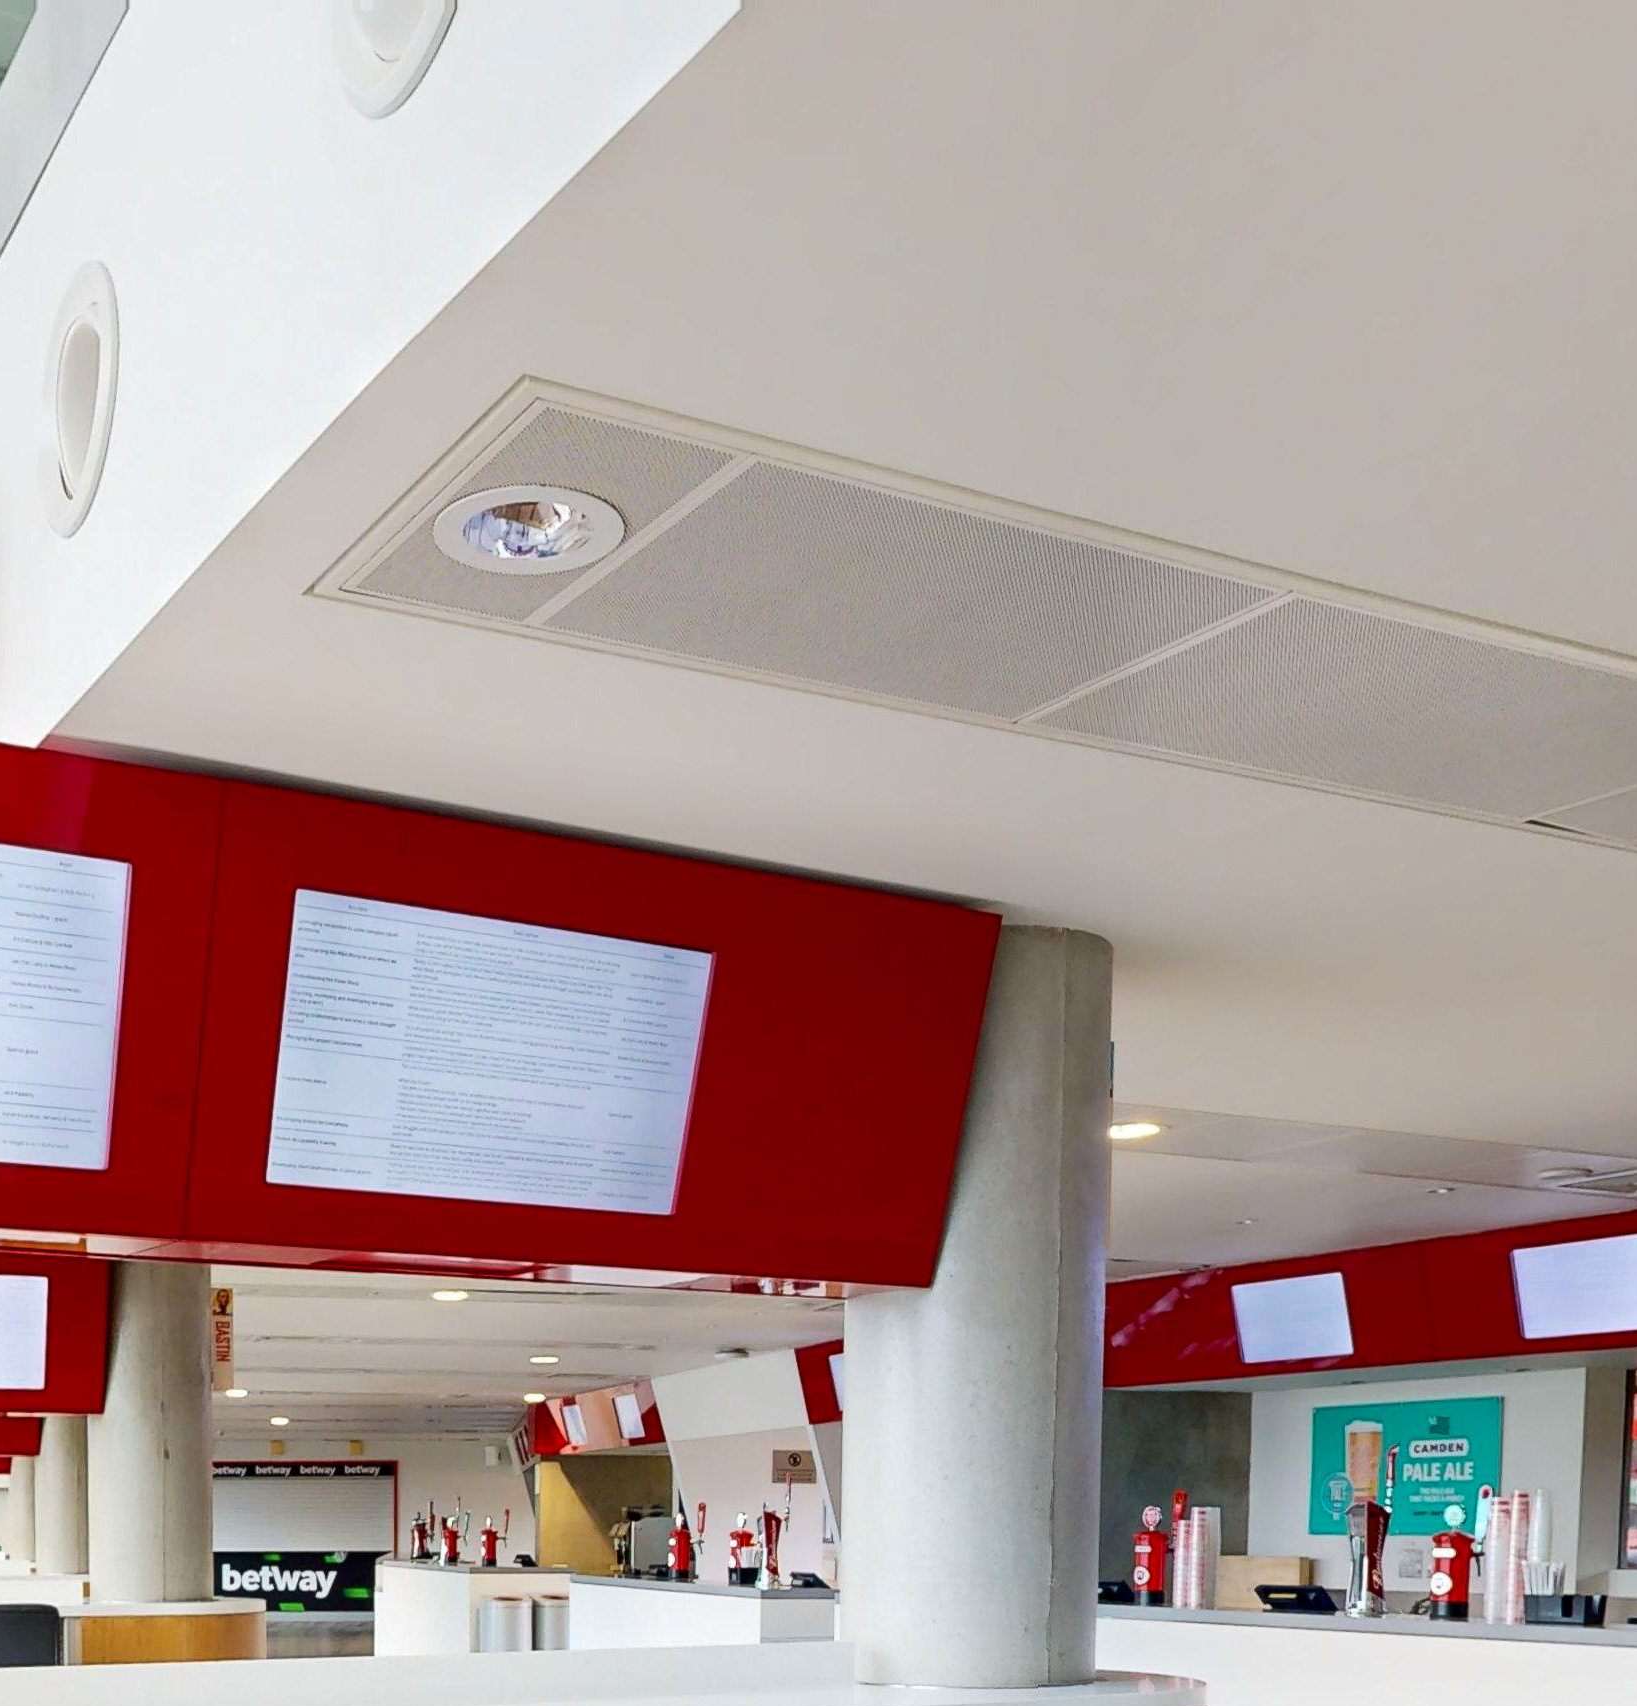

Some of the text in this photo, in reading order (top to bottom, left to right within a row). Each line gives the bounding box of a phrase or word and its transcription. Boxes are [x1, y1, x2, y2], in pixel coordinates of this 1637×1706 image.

[215, 1320, 231, 1362] BASTIN
[1413, 1443, 1465, 1454] CAMDEN
[255, 1465, 292, 1477] betway
[299, 1465, 336, 1477] betway
[344, 1465, 380, 1477] betway
[1402, 1461, 1475, 1482] PALE ALE
[221, 1563, 338, 1599] betway
